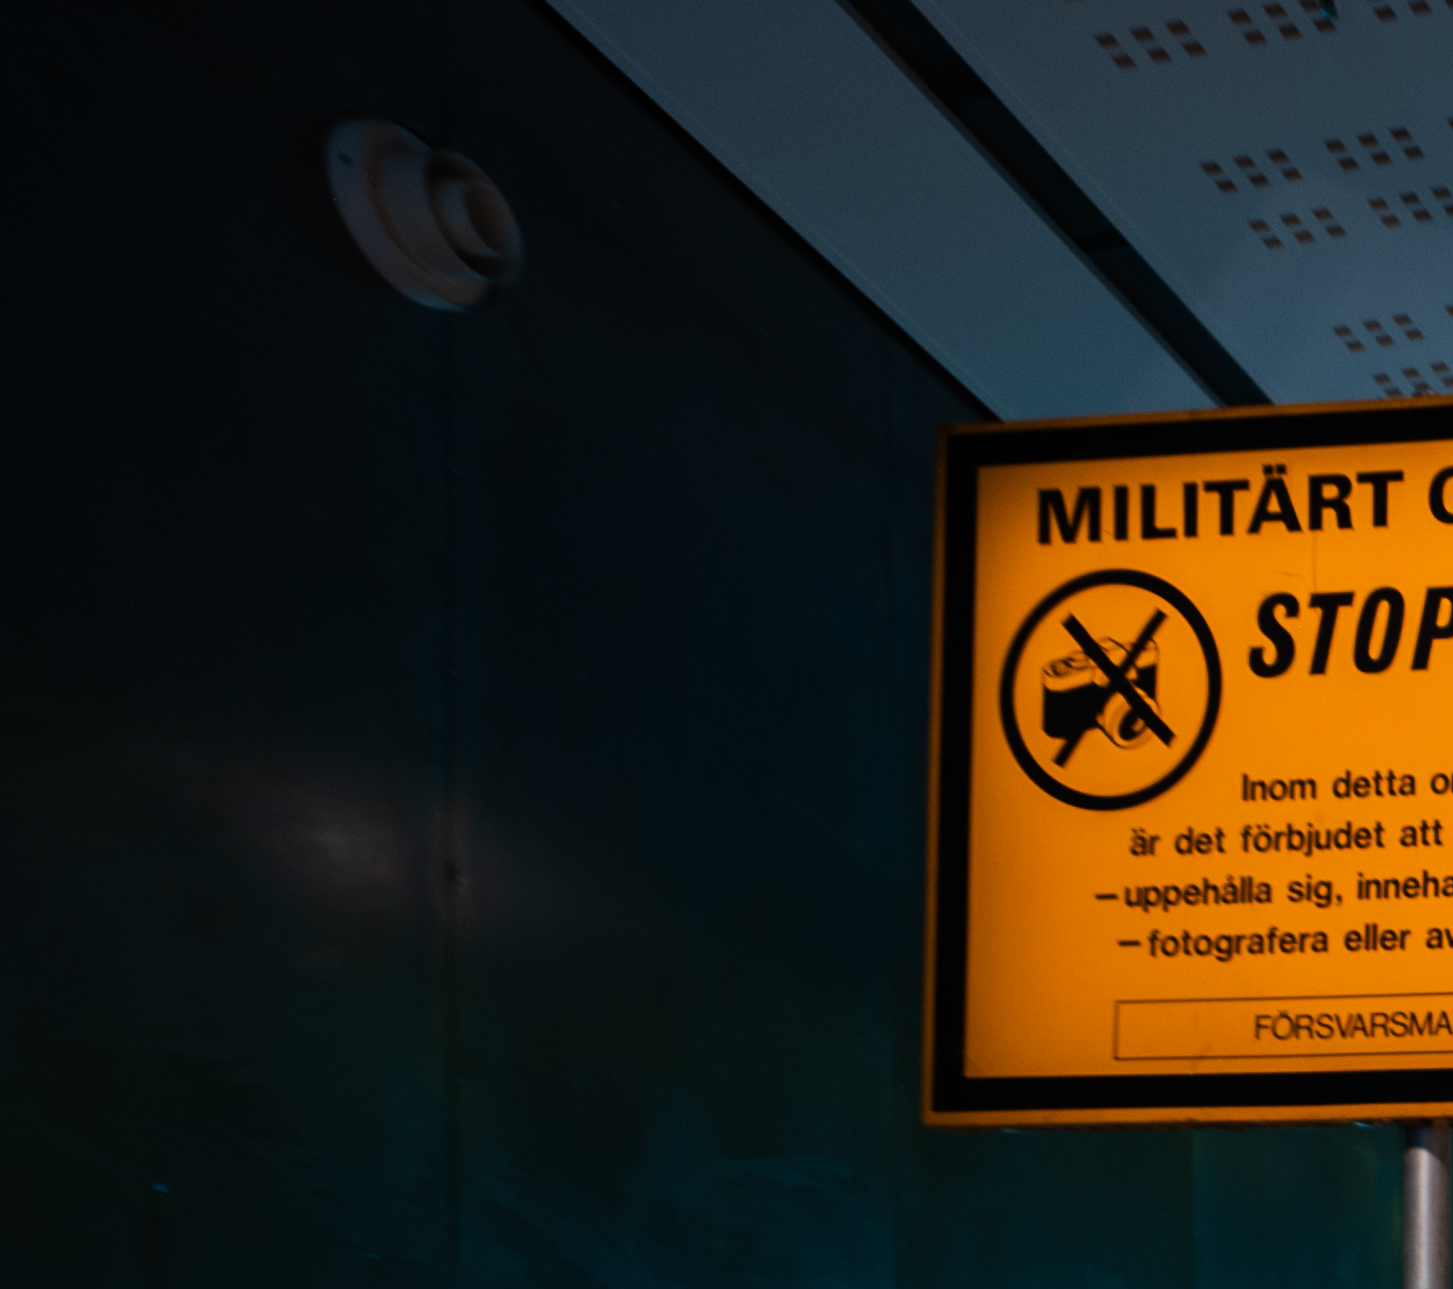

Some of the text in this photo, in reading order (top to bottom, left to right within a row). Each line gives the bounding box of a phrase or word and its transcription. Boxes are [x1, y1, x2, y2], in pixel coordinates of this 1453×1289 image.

[1036, 461, 1405, 545] MILITÄRT
[1240, 772, 1318, 802] Inom
[1330, 768, 1417, 800] detta
[1128, 827, 1161, 858] är
[1172, 825, 1226, 856] det
[1239, 819, 1385, 858] förbjudet
[1397, 817, 1444, 848] att
[1285, 872, 1343, 910] sig,
[1342, 921, 1412, 953] eller
